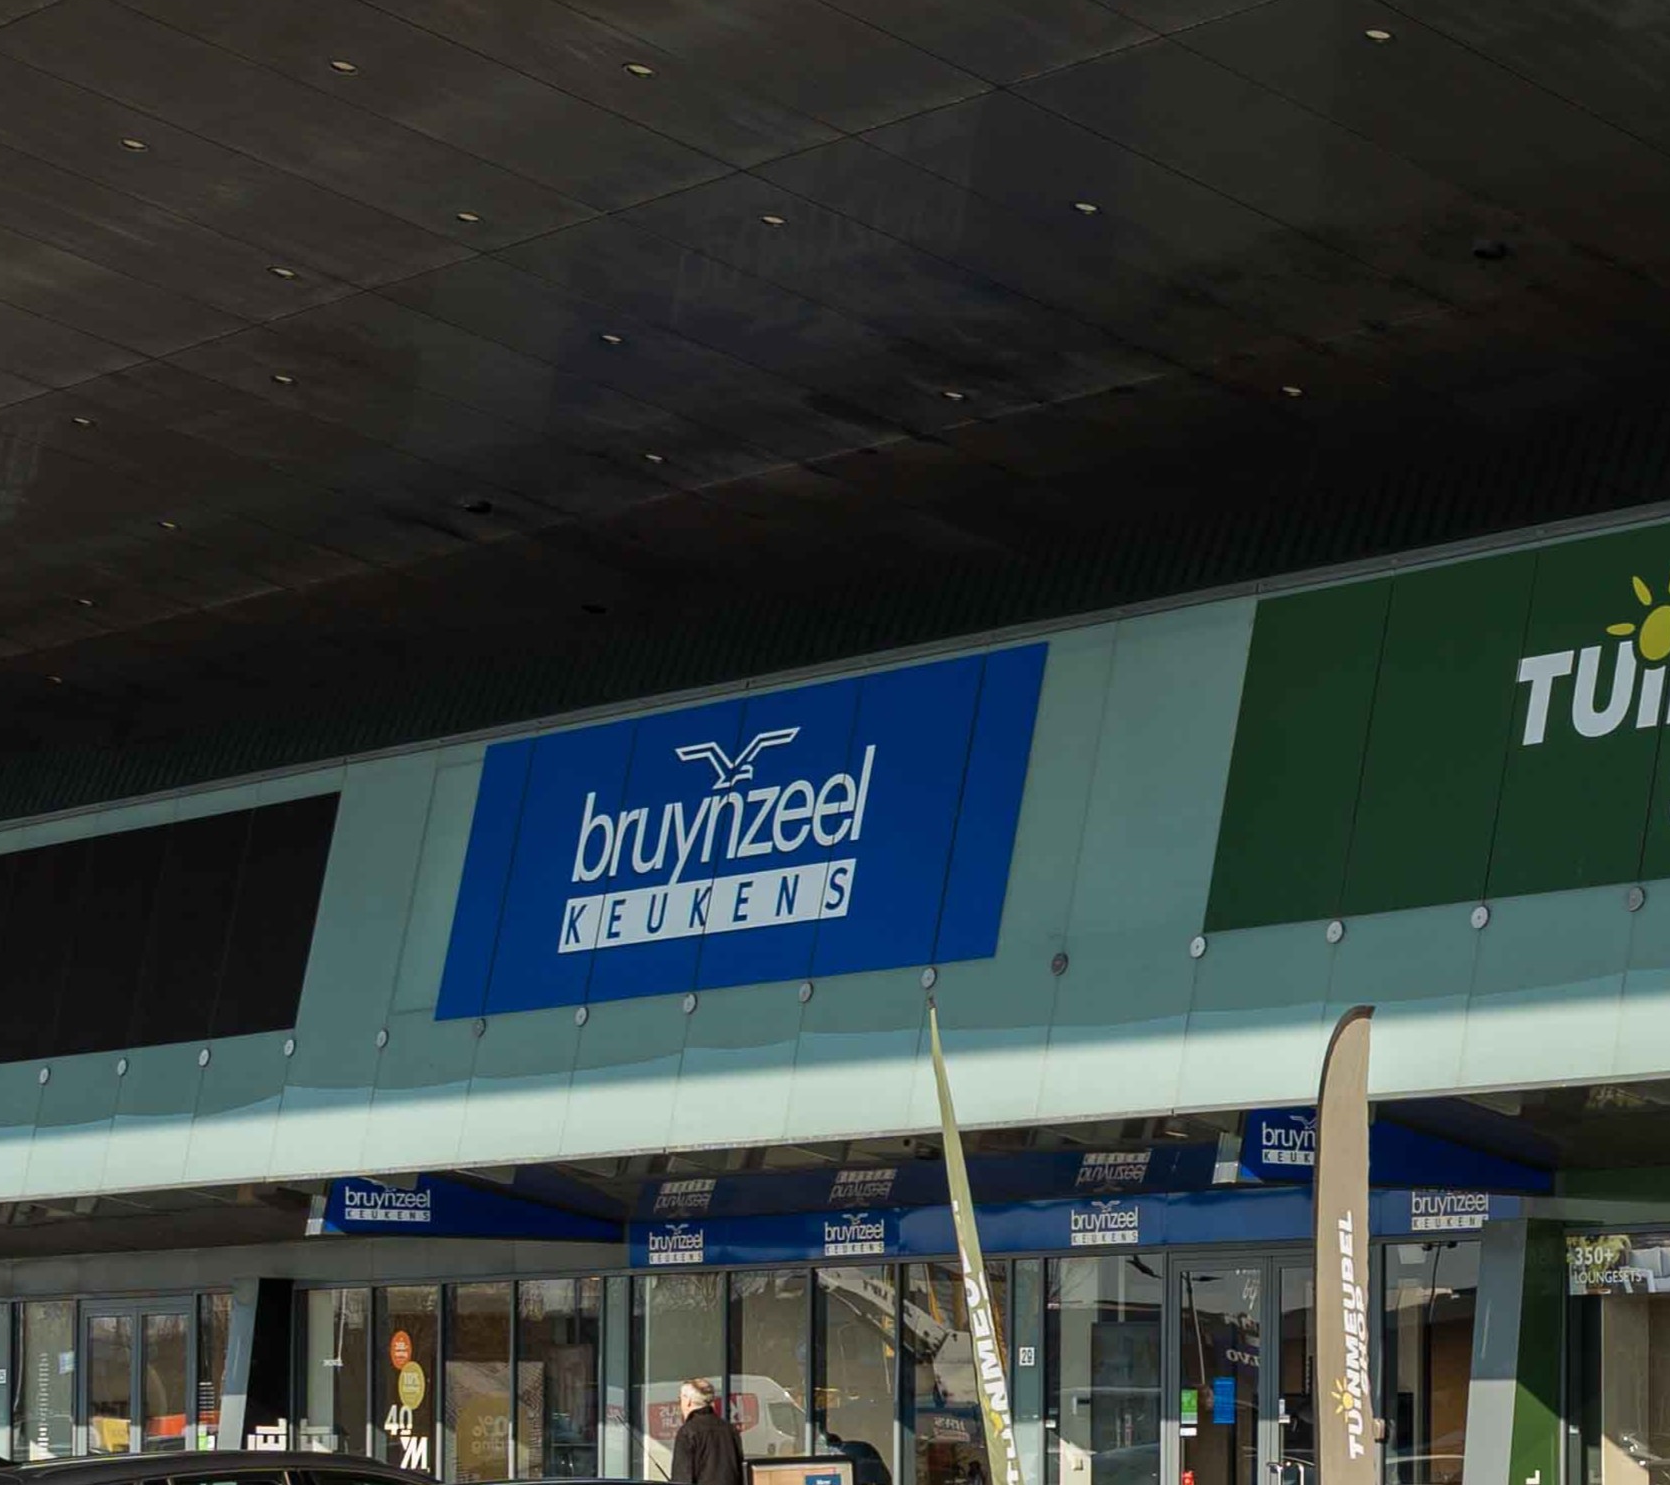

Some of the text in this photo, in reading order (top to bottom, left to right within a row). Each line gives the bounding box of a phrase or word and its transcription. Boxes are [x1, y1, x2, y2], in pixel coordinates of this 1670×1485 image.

[572, 744, 876, 885] bruynzeel
[563, 866, 851, 950] KEUKENS
[1262, 1121, 1316, 1150] bruyn
[1263, 1151, 1315, 1165] KEUK
[345, 1186, 430, 1209] bruynzeel
[1412, 1191, 1488, 1215] bruynzeel
[1071, 1206, 1139, 1232] bruynzeel
[1412, 1216, 1487, 1230] KEUKEN
[649, 1229, 703, 1253] bruynzeel
[825, 1219, 884, 1244] bruynzeel
[1574, 1246, 1614, 1265] 350+
[1574, 1270, 1643, 1284] LOUNGESETS
